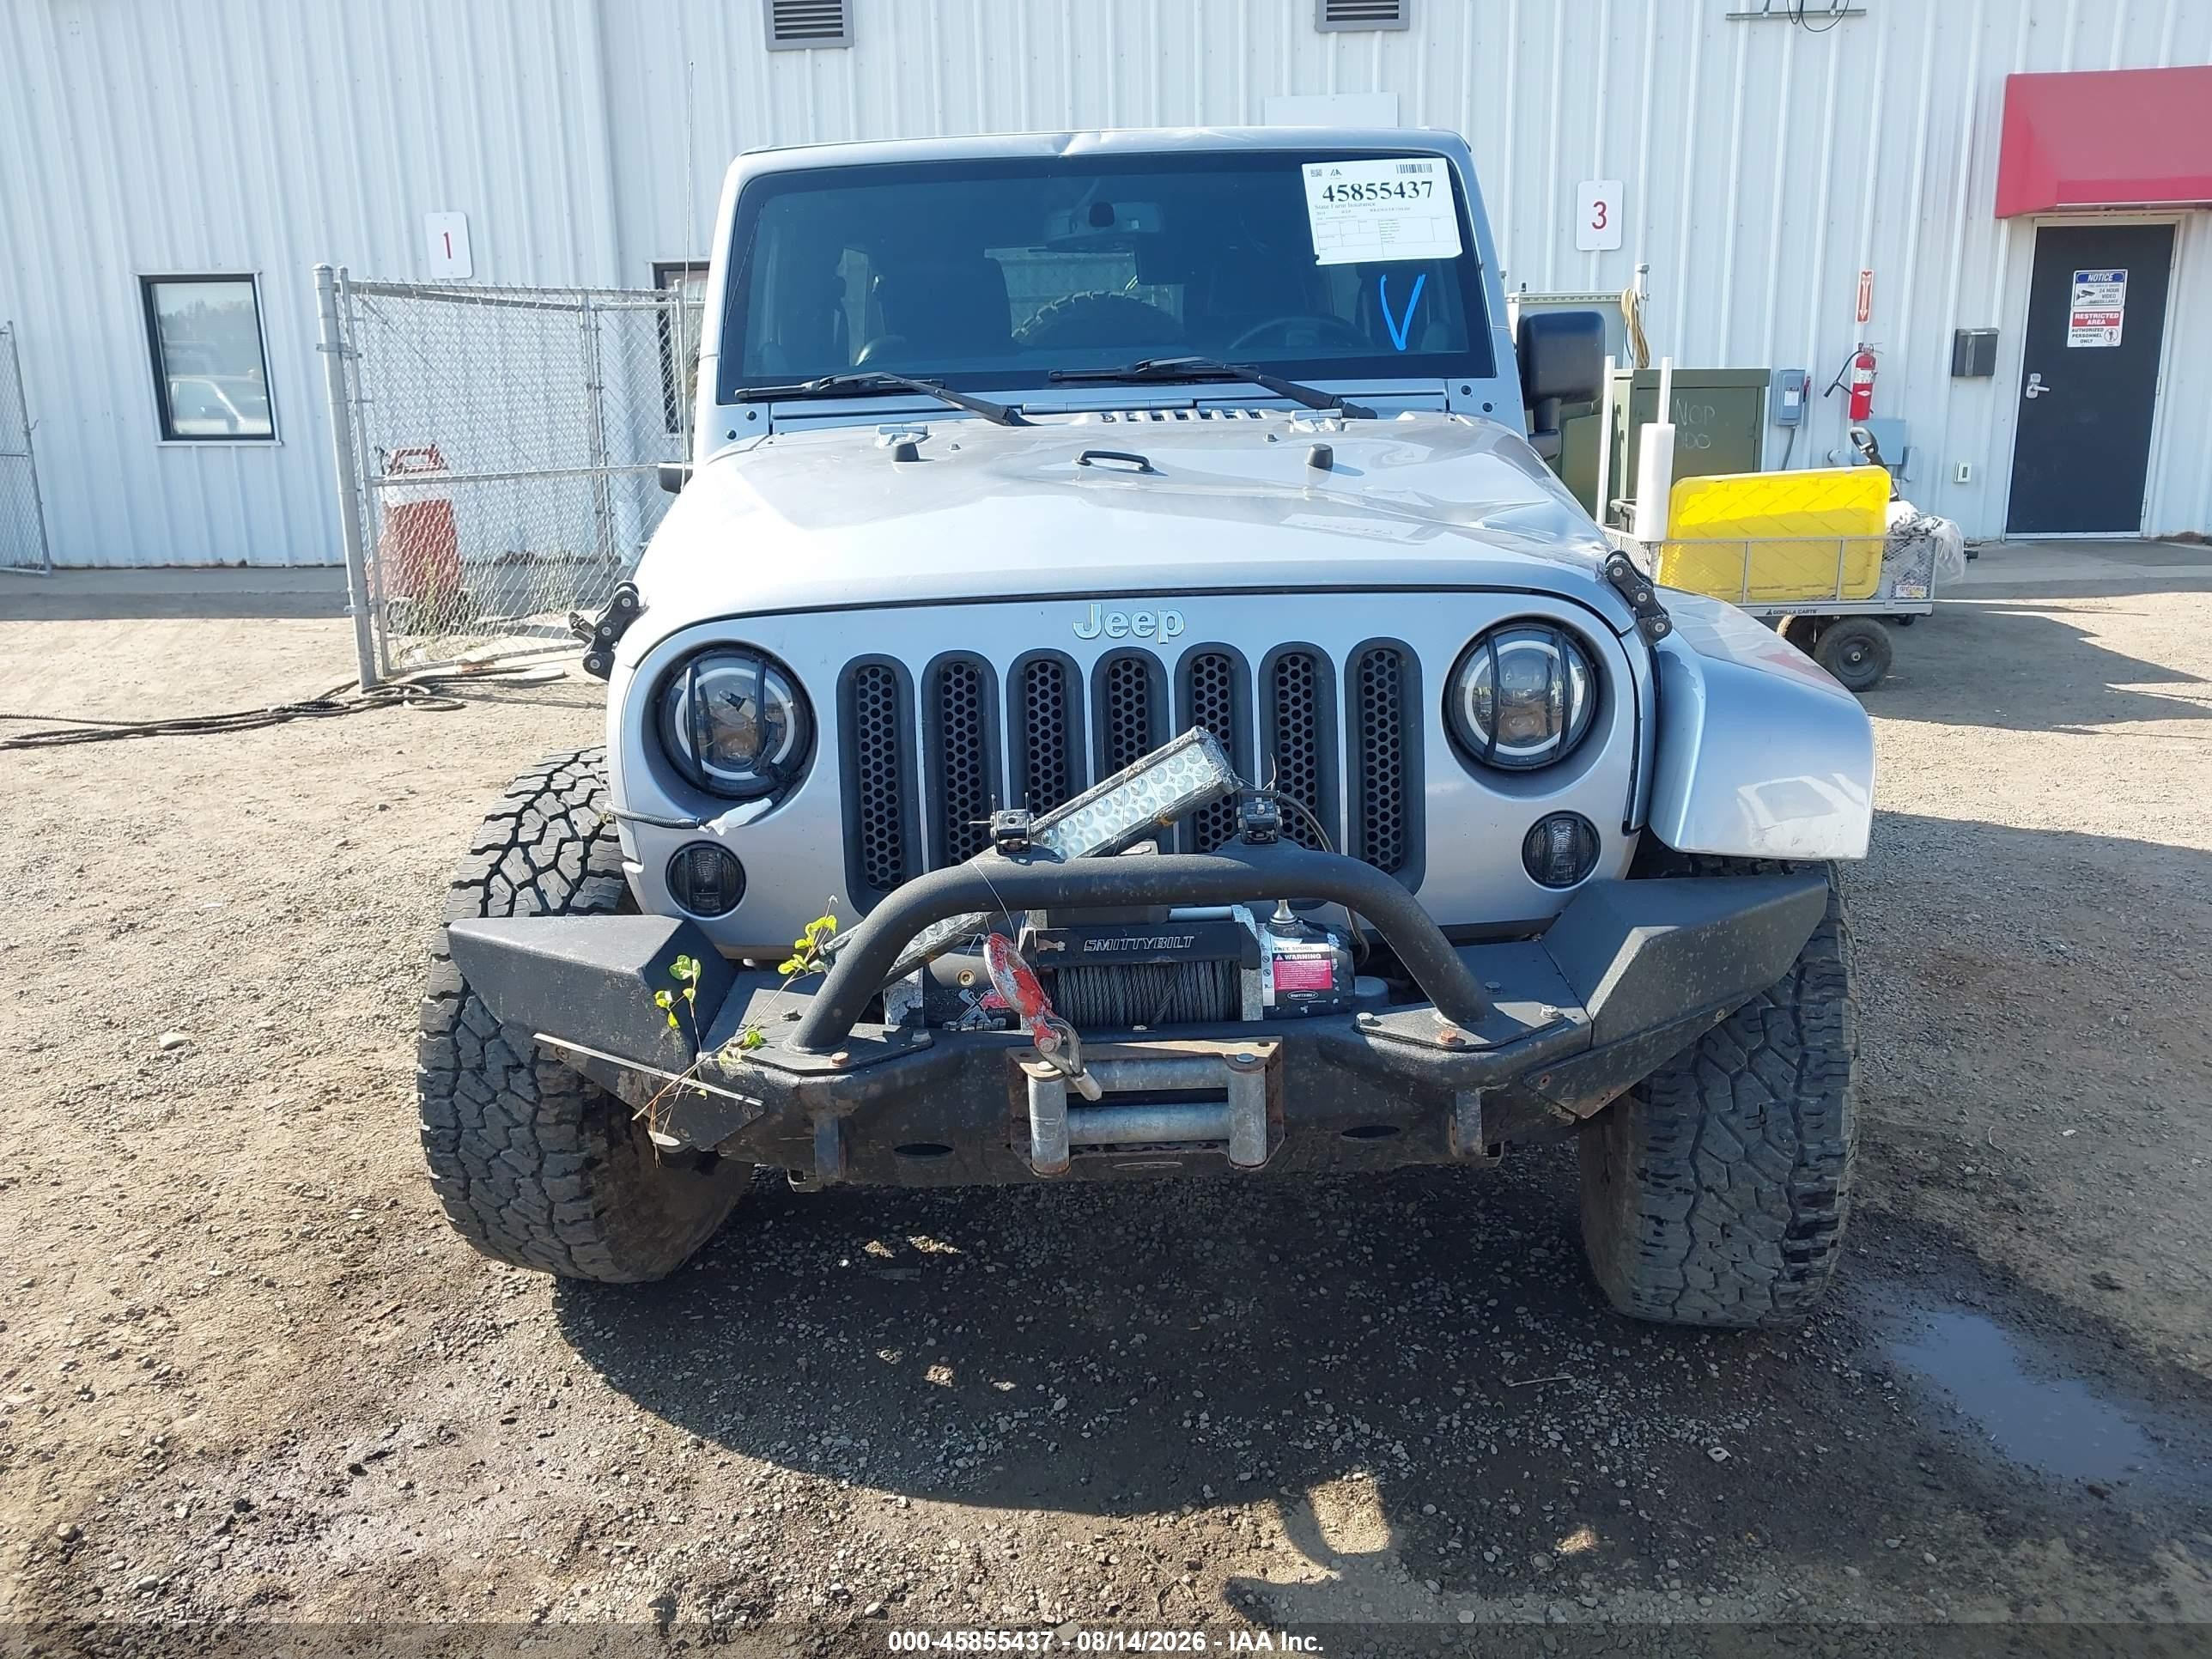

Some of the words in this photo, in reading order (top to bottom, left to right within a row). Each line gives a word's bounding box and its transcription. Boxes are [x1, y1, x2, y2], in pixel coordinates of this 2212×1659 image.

[1322, 180, 1433, 203] 45855437
[1591, 200, 1607, 230] 3
[443, 231, 453, 259] 1
[2087, 273, 2114, 283] NOTICE
[1380, 274, 1427, 351] V
[1073, 603, 1185, 645] Jeep
[1084, 935, 1195, 952] SMITTYBILT
